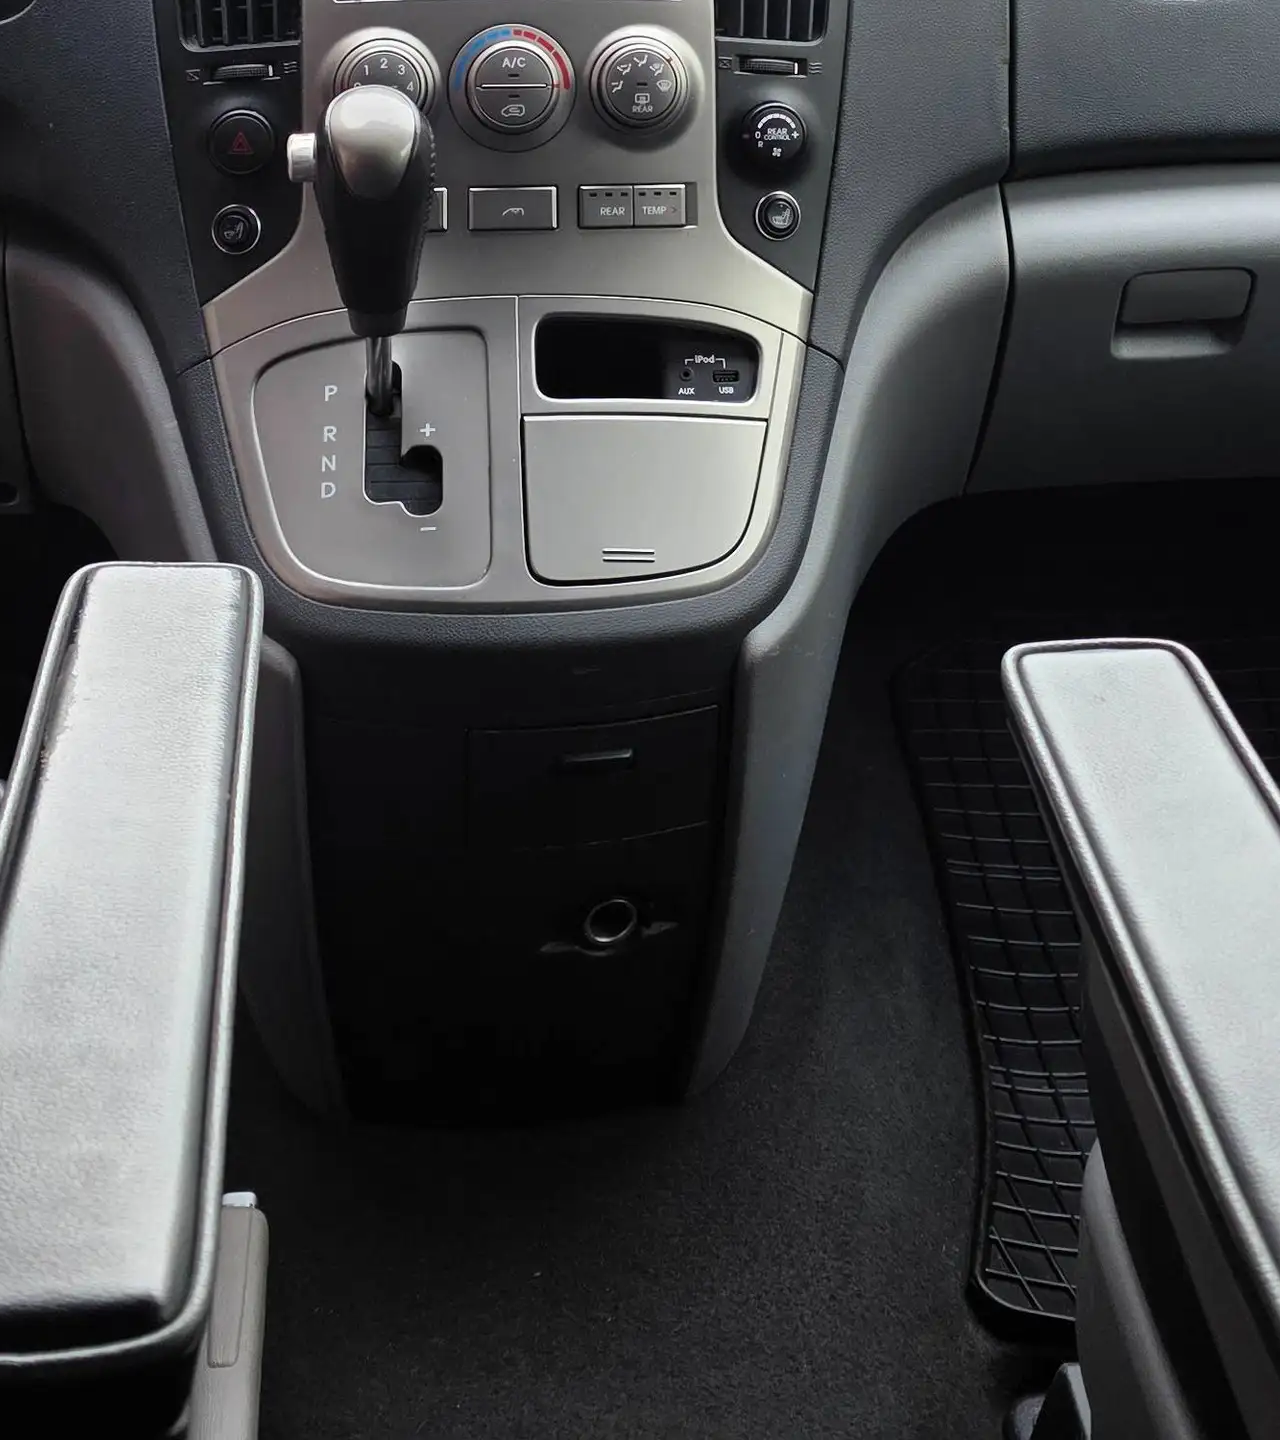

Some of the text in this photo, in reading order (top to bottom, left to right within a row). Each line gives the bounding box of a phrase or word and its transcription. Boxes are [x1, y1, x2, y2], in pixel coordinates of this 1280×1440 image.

[380, 57, 388, 69] 2
[502, 57, 526, 68] A/C
[363, 64, 369, 76] 1
[397, 64, 406, 75] 3
[406, 81, 414, 92] 4
[632, 104, 654, 113] REAR
[767, 127, 788, 135] REAR
[757, 140, 764, 148] R
[600, 206, 667, 216] REAR TEMP
[694, 354, 715, 364] iPod
[324, 384, 338, 402] P
[677, 387, 695, 395] AUX
[718, 386, 734, 394] USB
[323, 425, 337, 442] R
[321, 454, 336, 472] N
[320, 481, 336, 499] D
